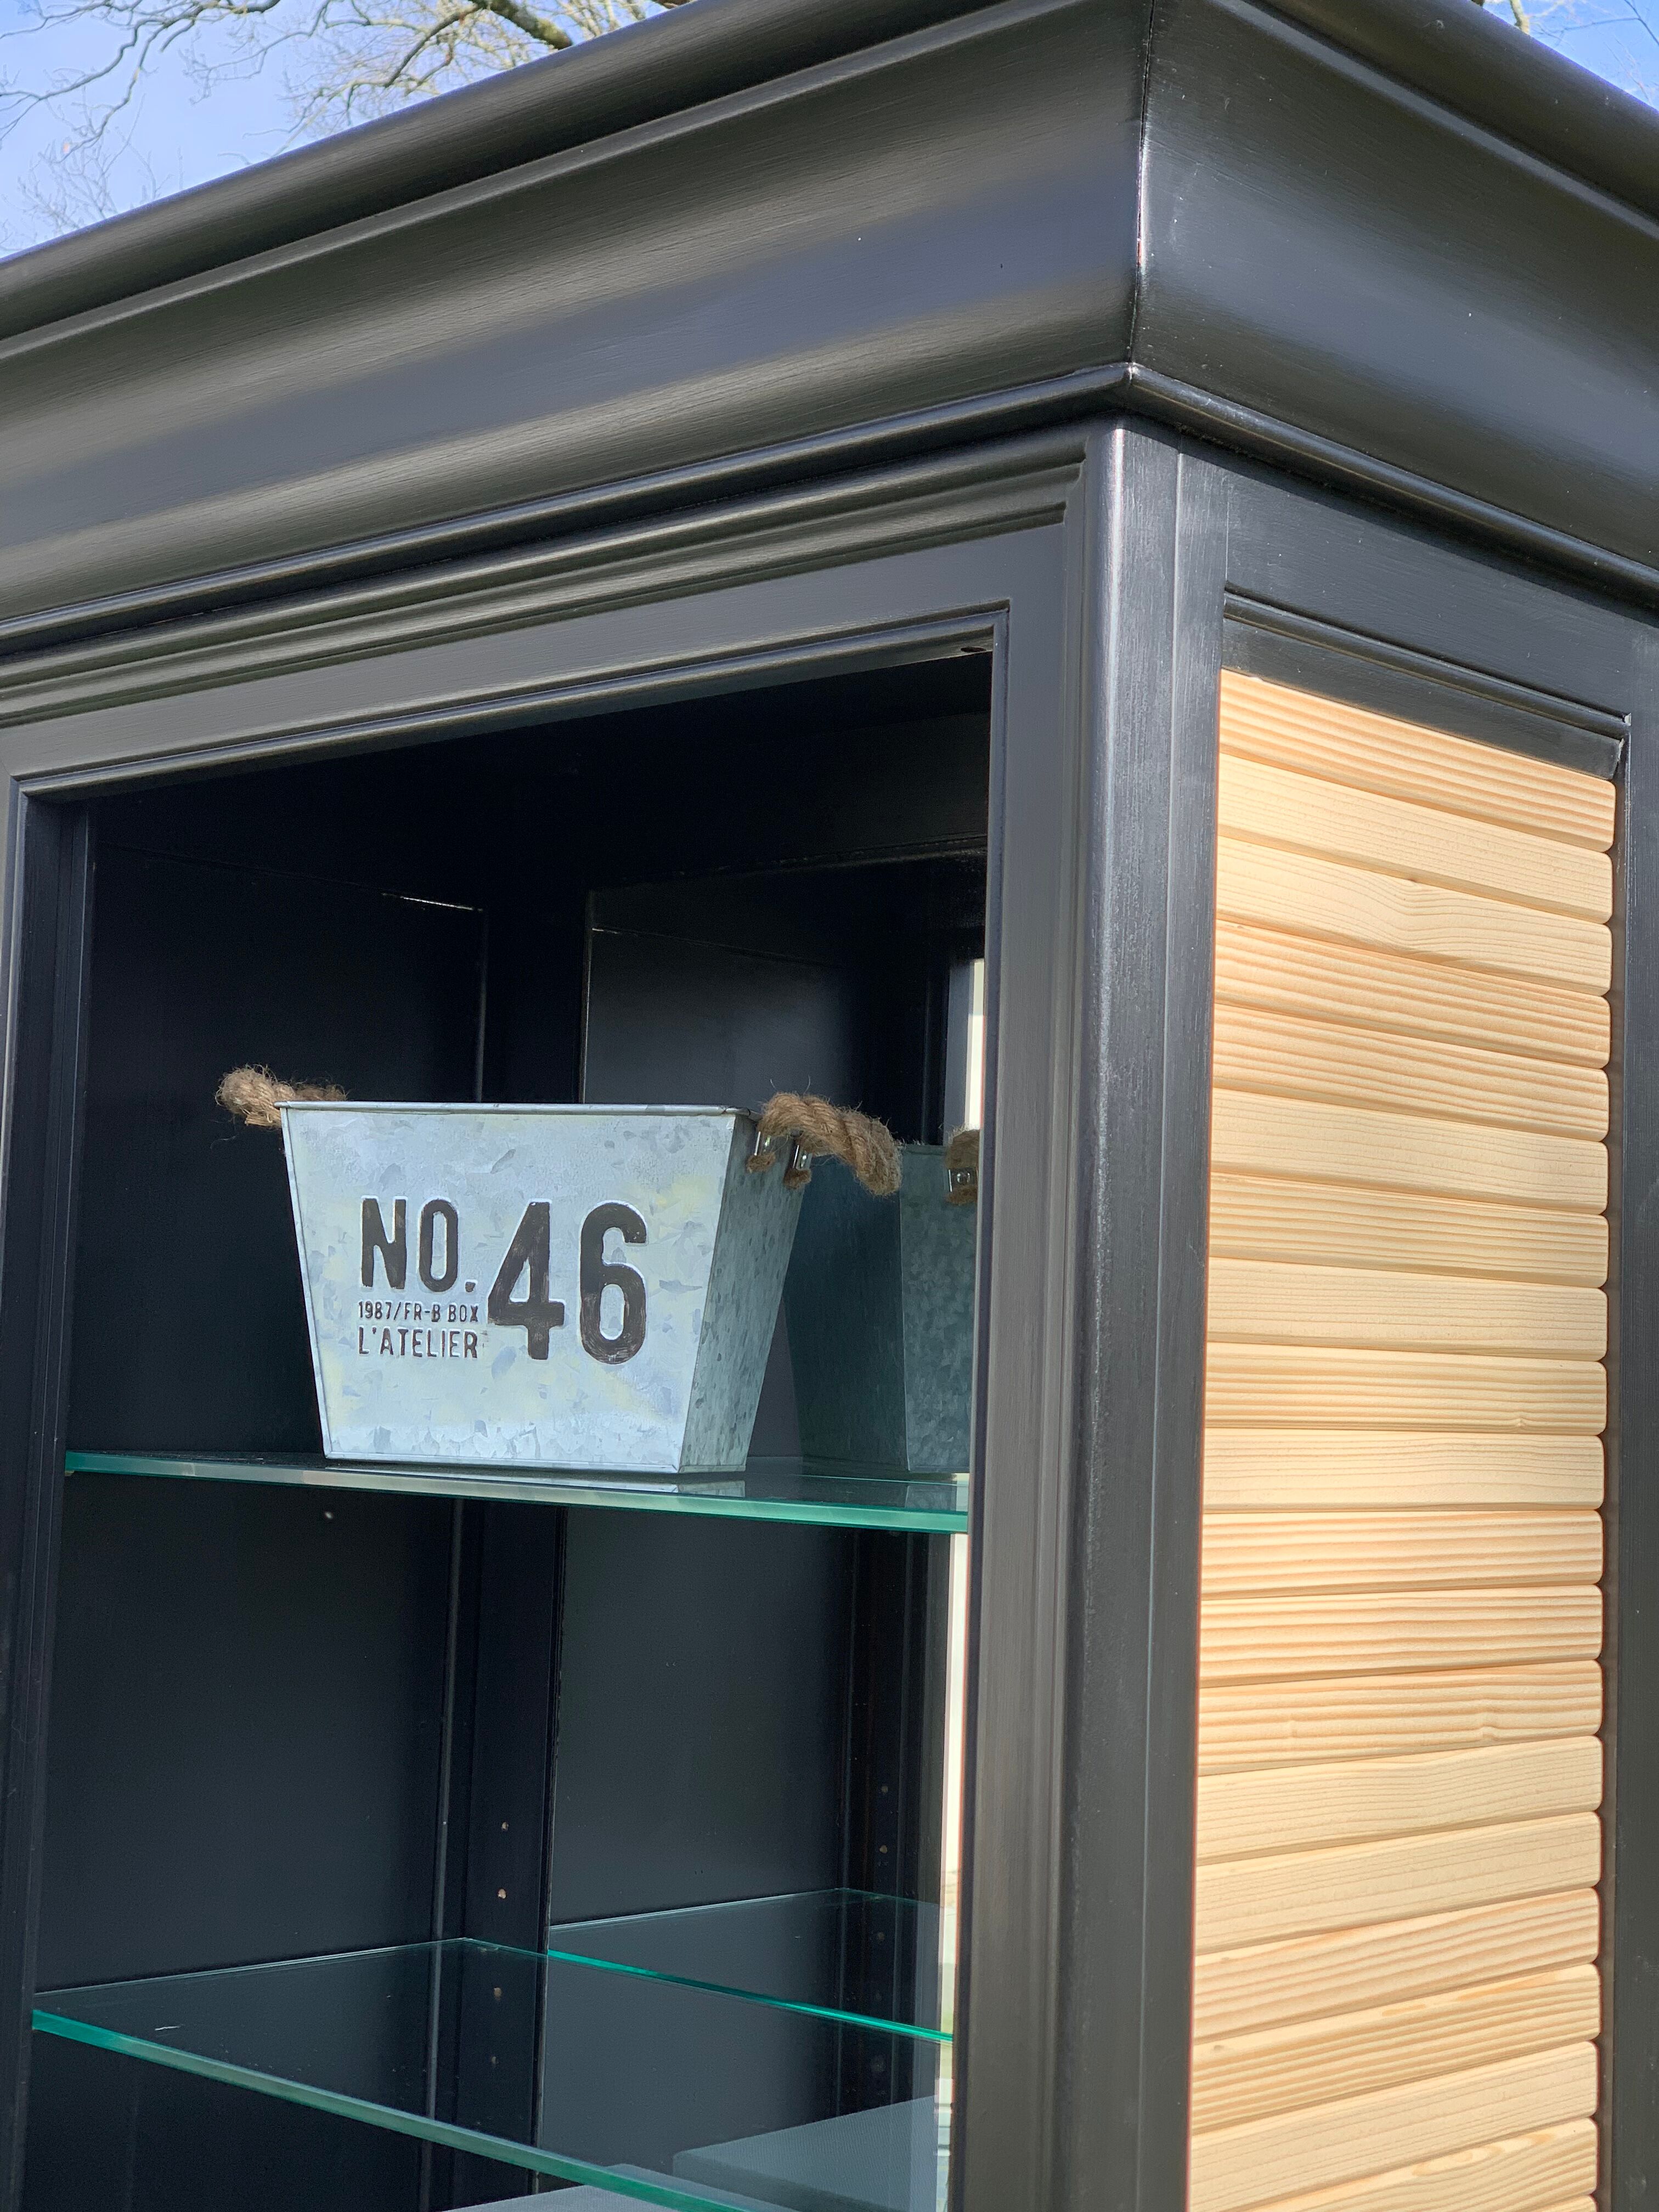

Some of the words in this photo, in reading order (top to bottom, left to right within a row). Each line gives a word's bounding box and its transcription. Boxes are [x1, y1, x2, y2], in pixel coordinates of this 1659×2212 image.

[361, 1198, 476, 1293] NO.
[487, 1201, 647, 1364] 46
[448, 1304, 479, 1323] BOX
[359, 1327, 478, 1358] L'ATELIER
